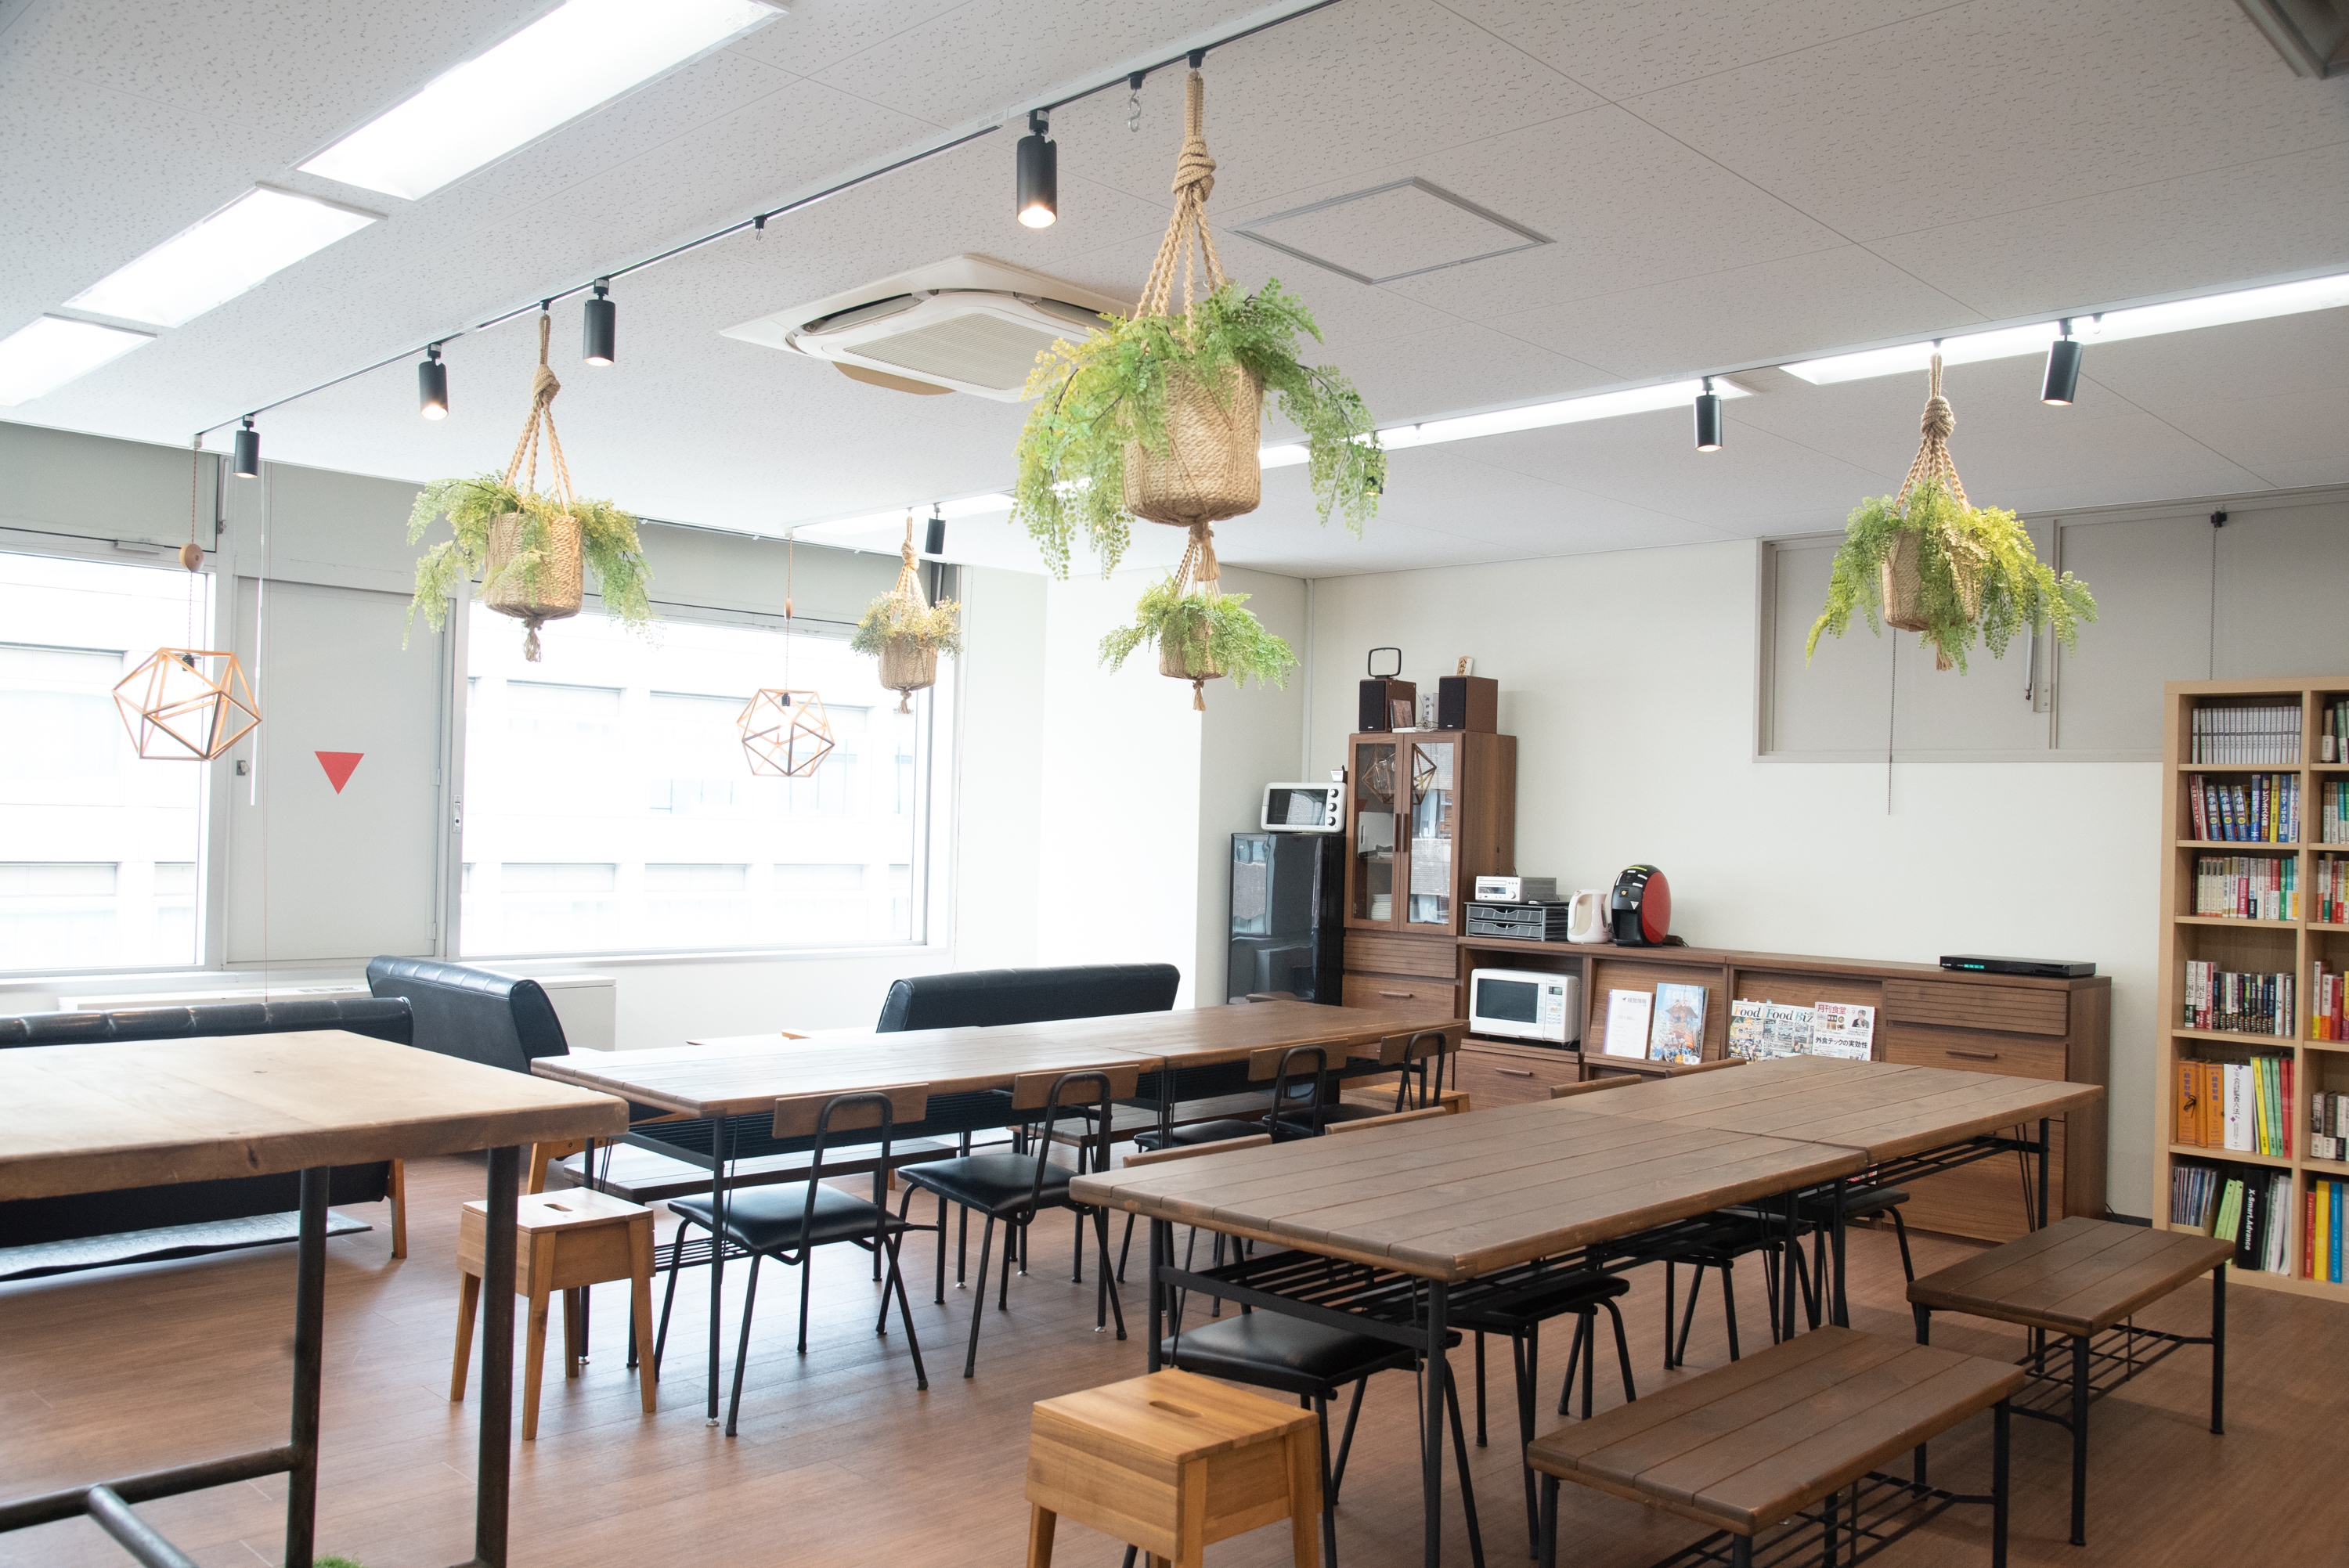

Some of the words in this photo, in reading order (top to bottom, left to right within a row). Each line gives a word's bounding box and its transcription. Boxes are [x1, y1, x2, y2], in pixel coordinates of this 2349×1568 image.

[1734, 1005, 1761, 1018] Food
[1766, 1008, 1795, 1021] Food
[1795, 1011, 1814, 1023] Biz
[1817, 1004, 1846, 1015] 月刊食堂
[1815, 1036, 1868, 1049] 外食テックの実効性
